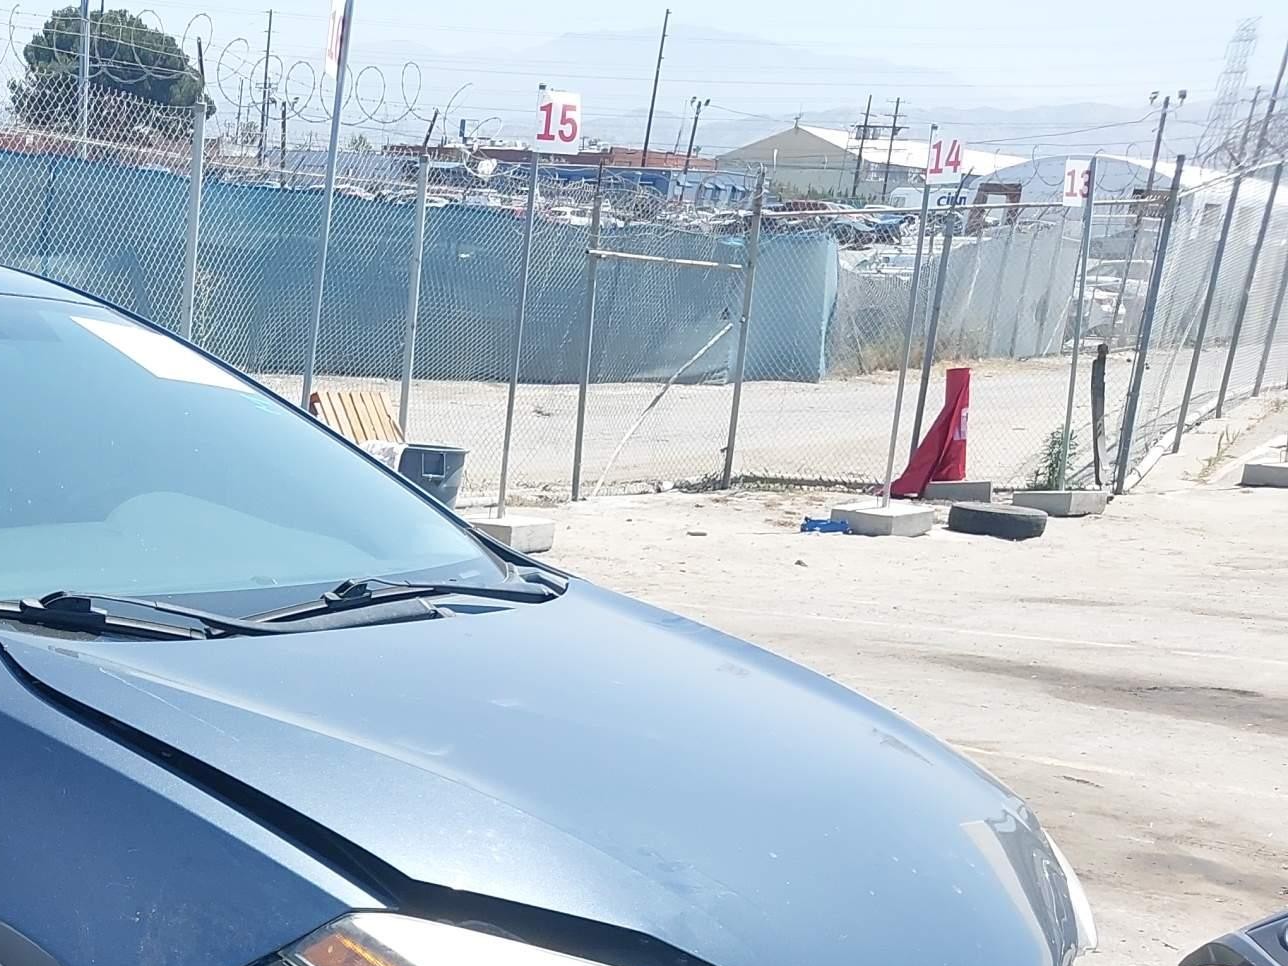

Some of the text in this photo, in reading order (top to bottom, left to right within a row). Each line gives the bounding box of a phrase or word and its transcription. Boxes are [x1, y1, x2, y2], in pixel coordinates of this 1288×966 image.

[536, 102, 578, 142] 15
[929, 139, 961, 174] 14
[1064, 168, 1091, 198] 13
